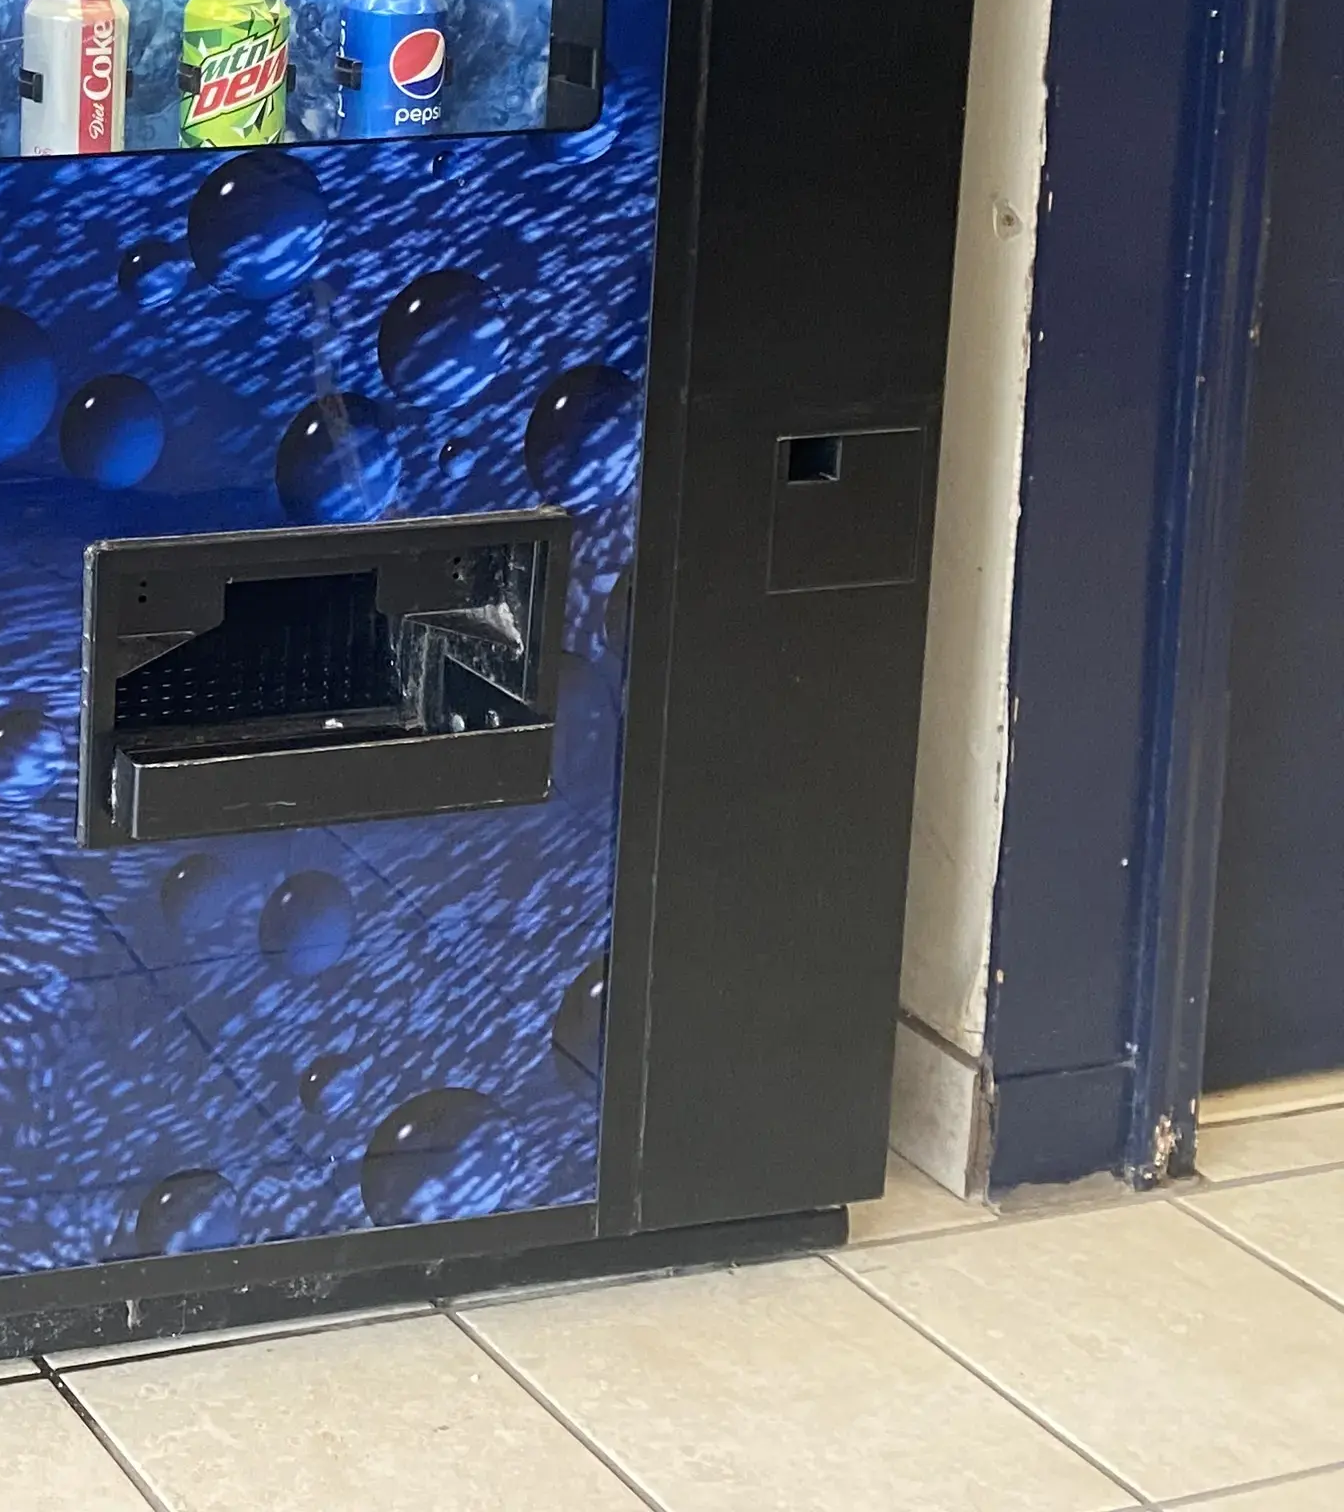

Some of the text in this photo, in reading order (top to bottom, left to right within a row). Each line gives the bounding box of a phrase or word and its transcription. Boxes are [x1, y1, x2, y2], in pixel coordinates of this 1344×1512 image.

[82, 19, 115, 140] Diet Coke
[395, 102, 442, 126] pepsi
